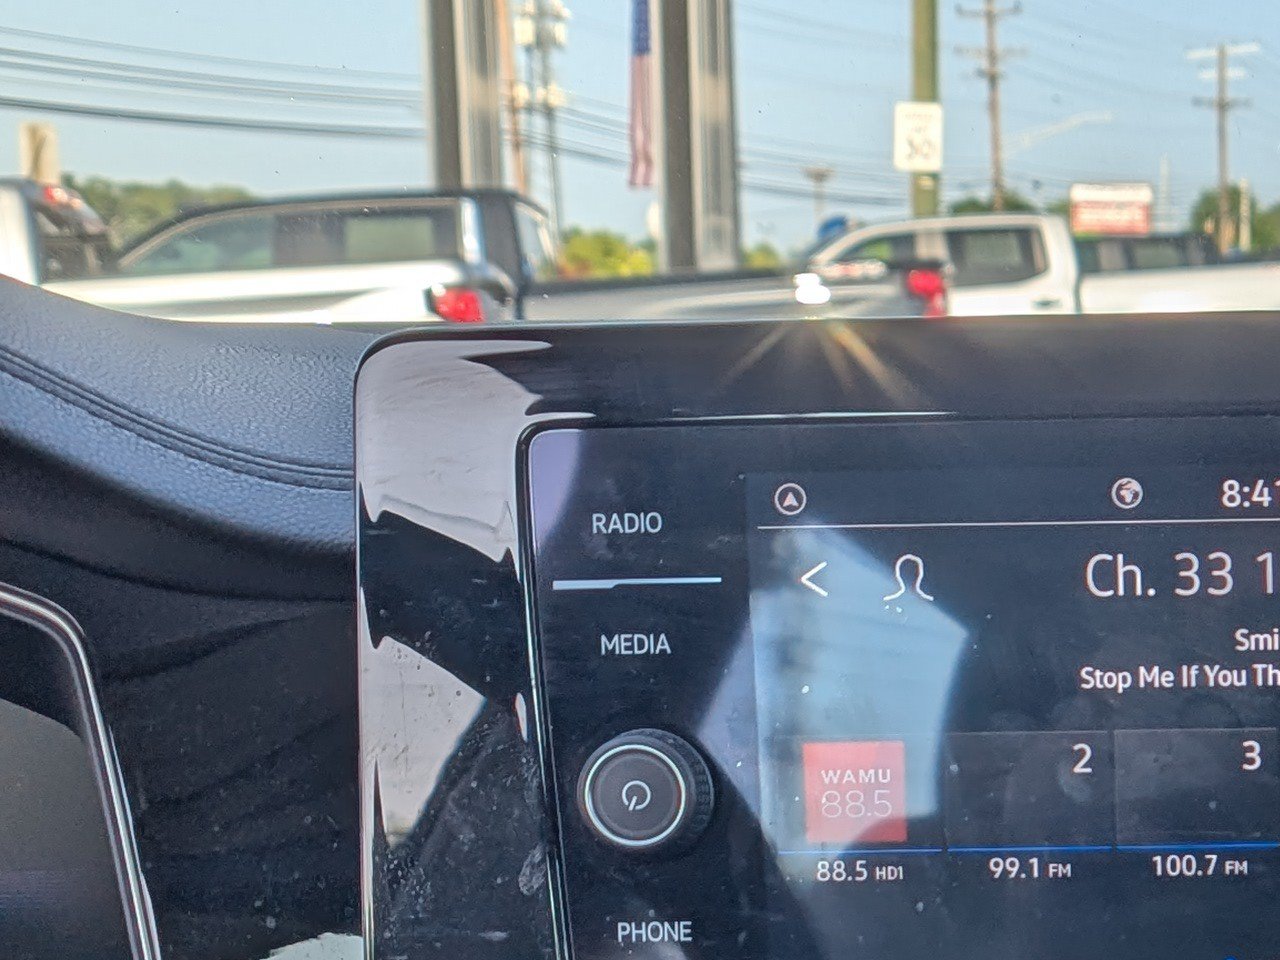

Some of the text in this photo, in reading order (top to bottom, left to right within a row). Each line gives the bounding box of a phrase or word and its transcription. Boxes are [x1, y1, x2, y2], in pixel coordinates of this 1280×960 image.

[591, 511, 663, 535] RADIO
[1085, 552, 1157, 598] Ch.
[1173, 550, 1234, 596] 33
[600, 633, 672, 656] MEDIA
[1080, 666, 1132, 694] Stop
[1138, 665, 1175, 689] Me
[1181, 664, 1200, 688] If
[1203, 663, 1247, 688] You
[1072, 743, 1094, 775] 2
[1240, 739, 1263, 772] 3
[820, 768, 891, 785] WAMU
[821, 789, 893, 818] 88.5
[816, 859, 904, 882] 88.5 HD1
[988, 857, 1073, 879] 99.1 FM
[1152, 854, 1249, 877] 100.7 FM
[617, 920, 694, 943] PHONE
